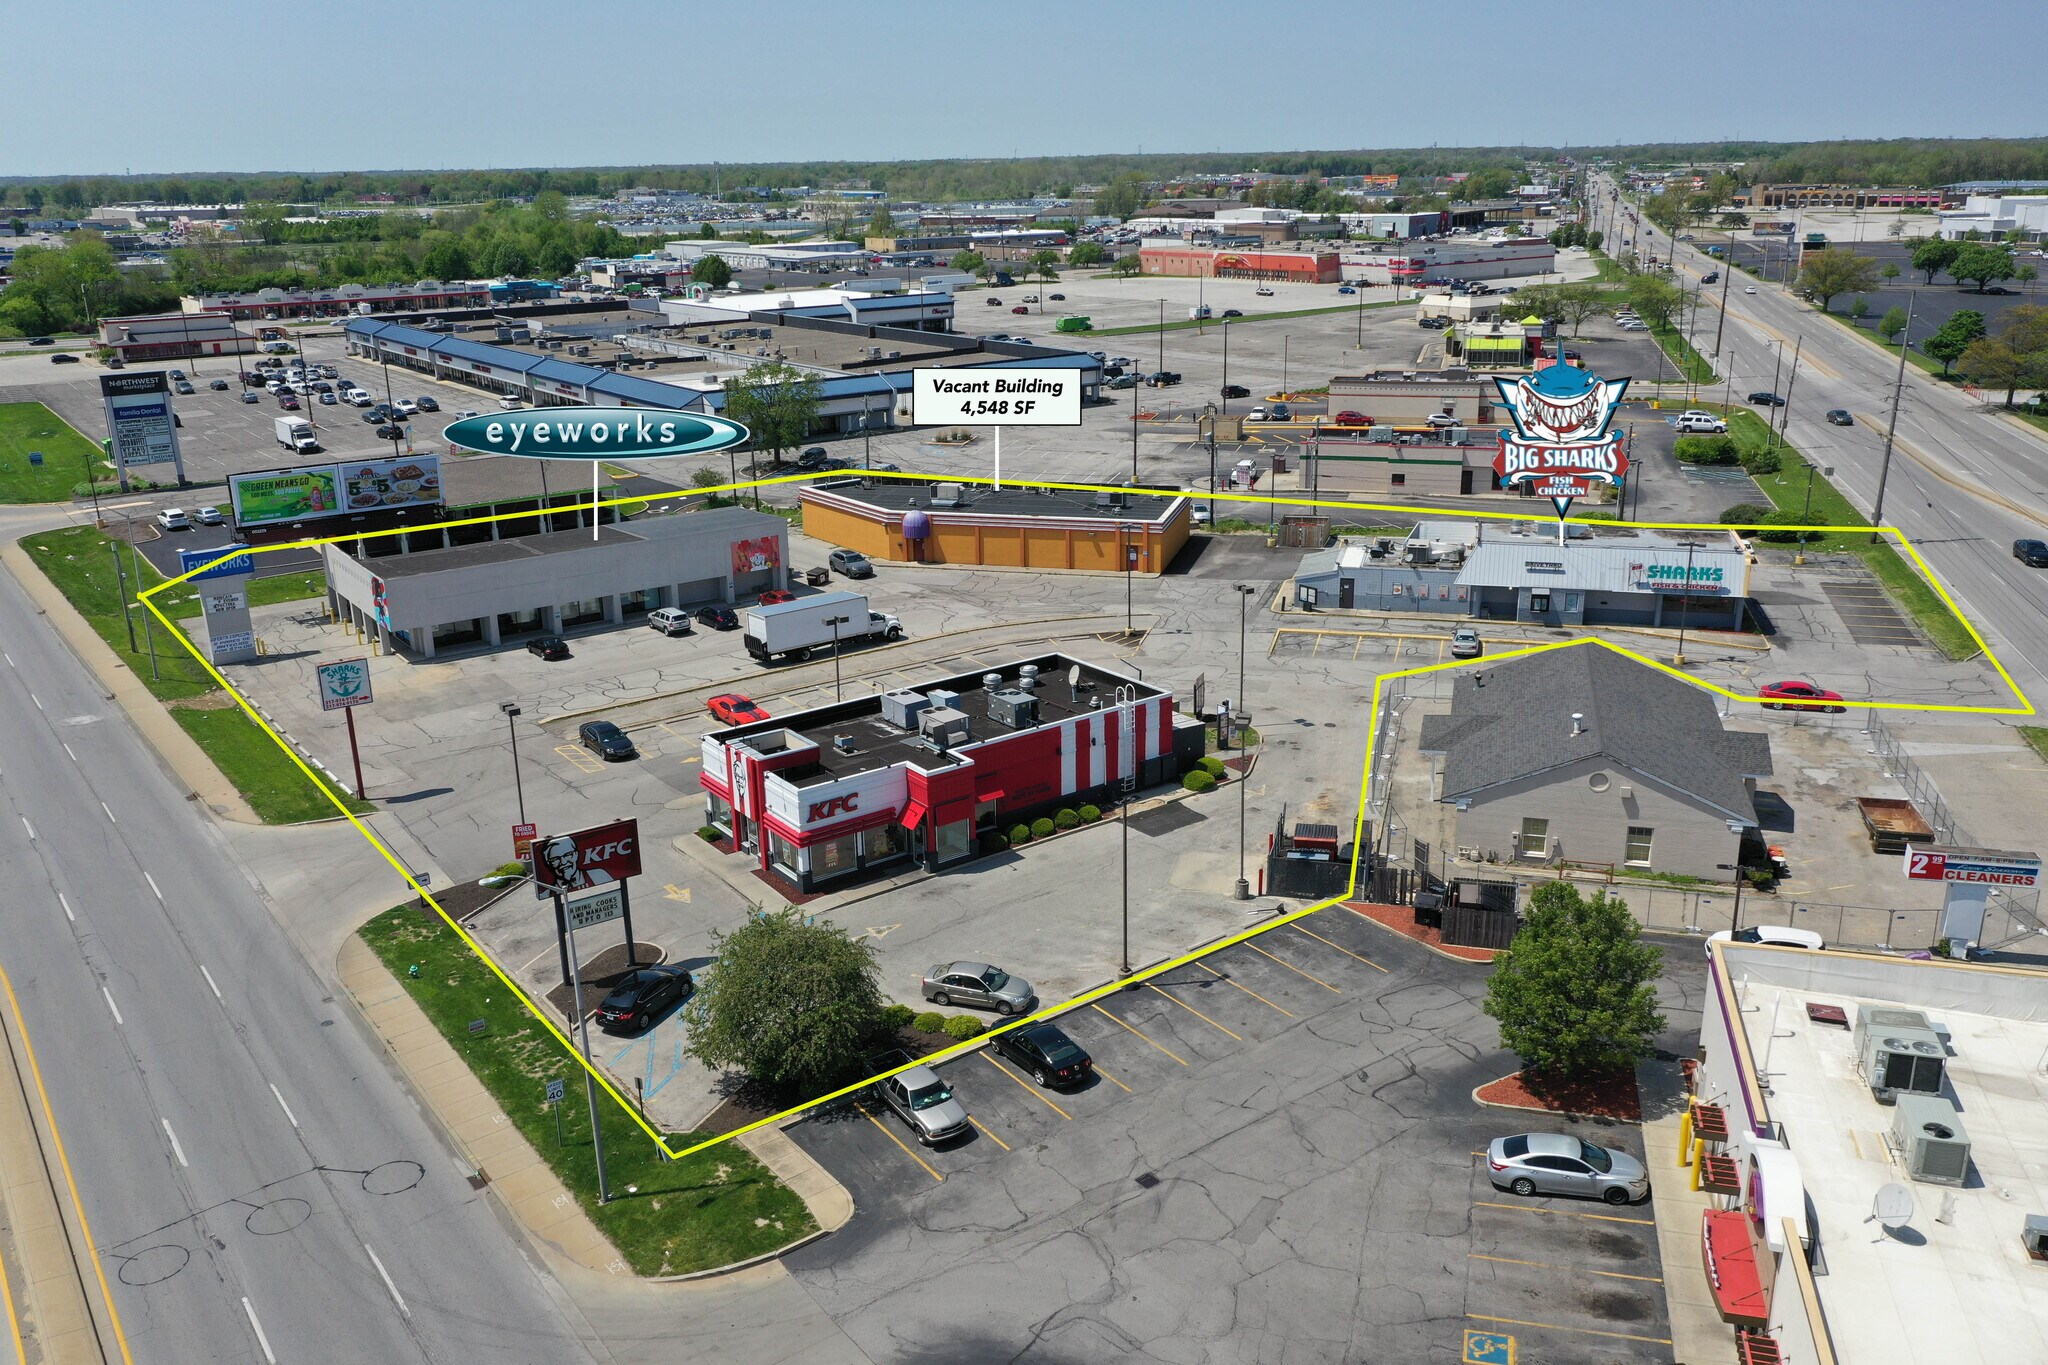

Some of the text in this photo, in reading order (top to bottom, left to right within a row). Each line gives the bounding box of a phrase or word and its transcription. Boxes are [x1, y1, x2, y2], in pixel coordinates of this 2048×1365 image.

[109, 377, 159, 387] NORTHWEST
[250, 477, 310, 492] GREEN MEANS GO
[1647, 565, 1724, 582] SHARKS
[327, 664, 361, 680] SHARKS
[806, 792, 858, 823] KFC
[583, 838, 632, 866] KFC
[1910, 854, 1929, 874] 2
[1944, 870, 2035, 886] CLEANERS
[570, 896, 618, 914] HIRING COOKS
[572, 903, 618, 920] AND MANAGERS
[547, 1080, 562, 1088] SPEED
[548, 1090, 562, 1100] 40
